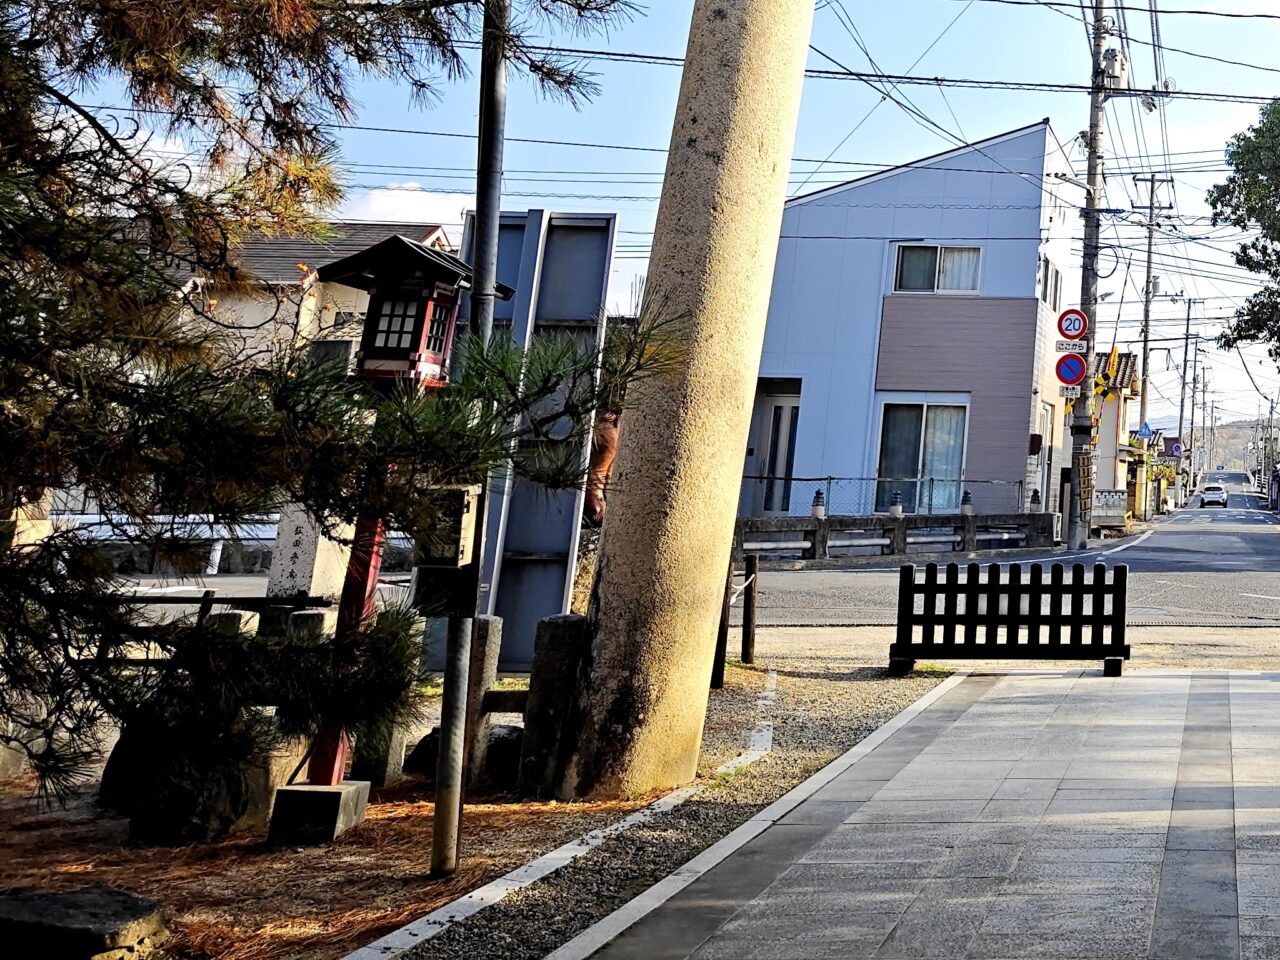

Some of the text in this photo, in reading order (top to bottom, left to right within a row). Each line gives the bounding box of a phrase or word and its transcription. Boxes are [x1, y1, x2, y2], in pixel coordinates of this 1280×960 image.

[1064, 318, 1081, 331] 20
[1058, 343, 1084, 351] ここから
